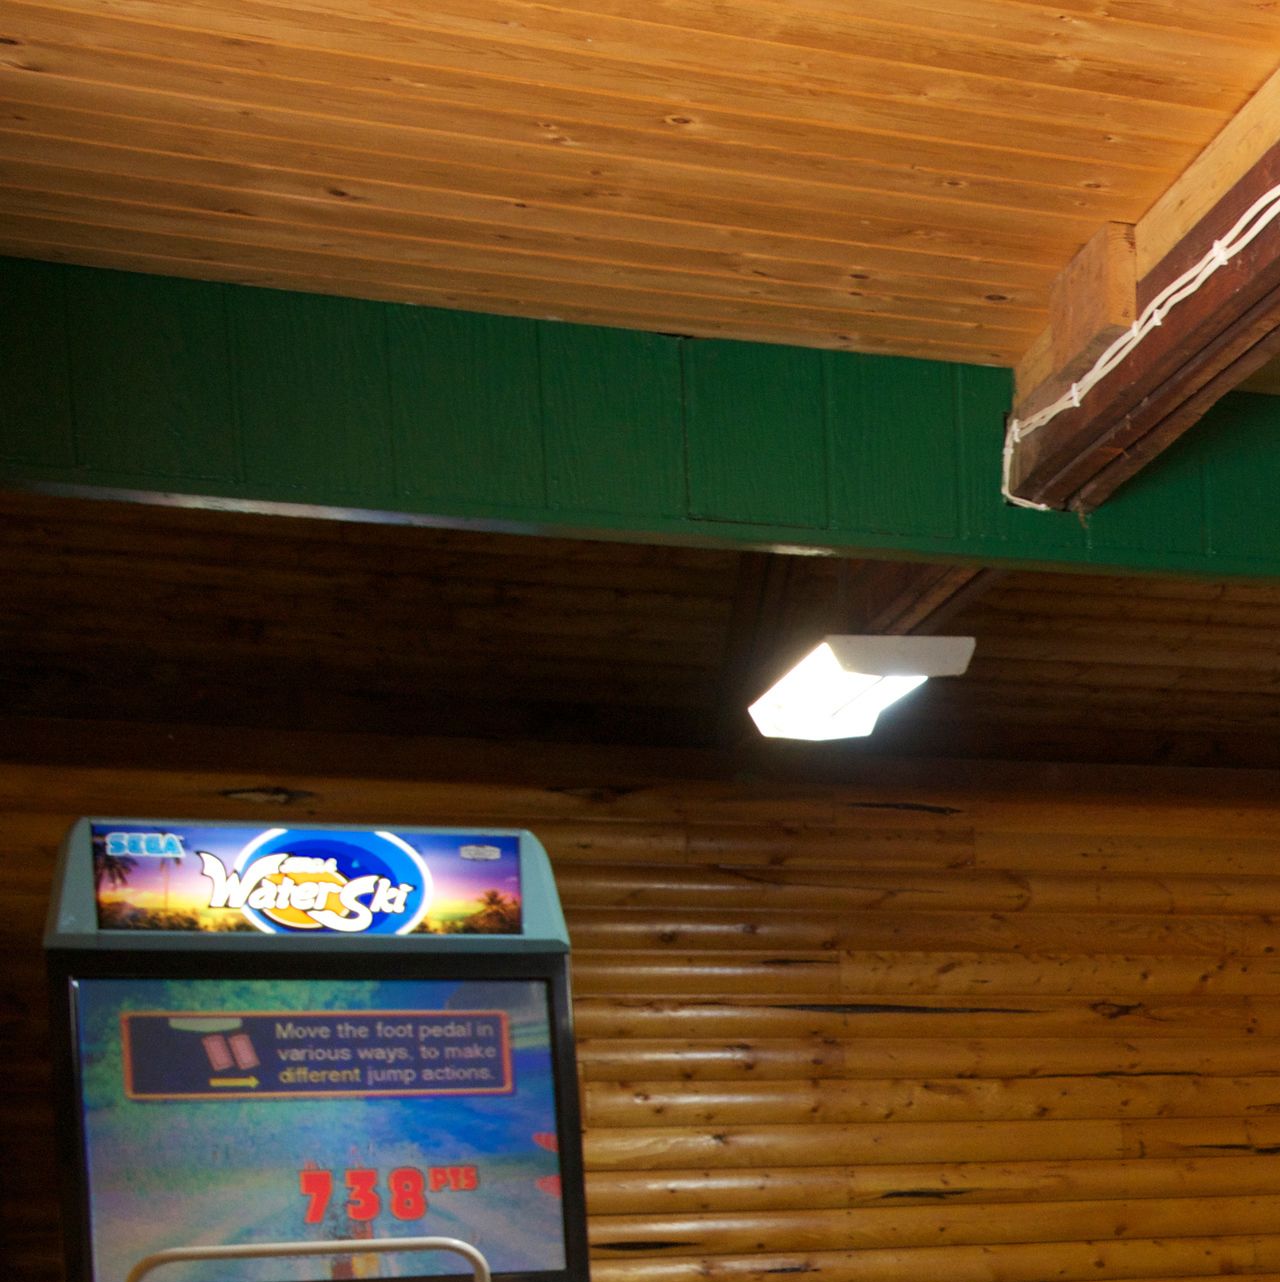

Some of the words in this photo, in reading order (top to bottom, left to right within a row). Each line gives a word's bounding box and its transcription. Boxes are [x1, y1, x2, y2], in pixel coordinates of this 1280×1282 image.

[105, 832, 185, 859] SEGA
[197, 850, 342, 910] Water
[307, 874, 415, 933] Ski
[275, 1022, 331, 1039] Move
[336, 1022, 369, 1038] the
[375, 1022, 413, 1038] foot
[419, 1021, 472, 1041] pedal
[477, 1021, 493, 1037] in
[278, 1044, 351, 1061] various
[420, 1044, 440, 1059] to
[445, 1043, 497, 1058] make
[279, 1066, 361, 1083] different
[367, 1066, 416, 1085] jump
[300, 1167, 428, 1224] 738
[429, 1164, 480, 1192] PTS
